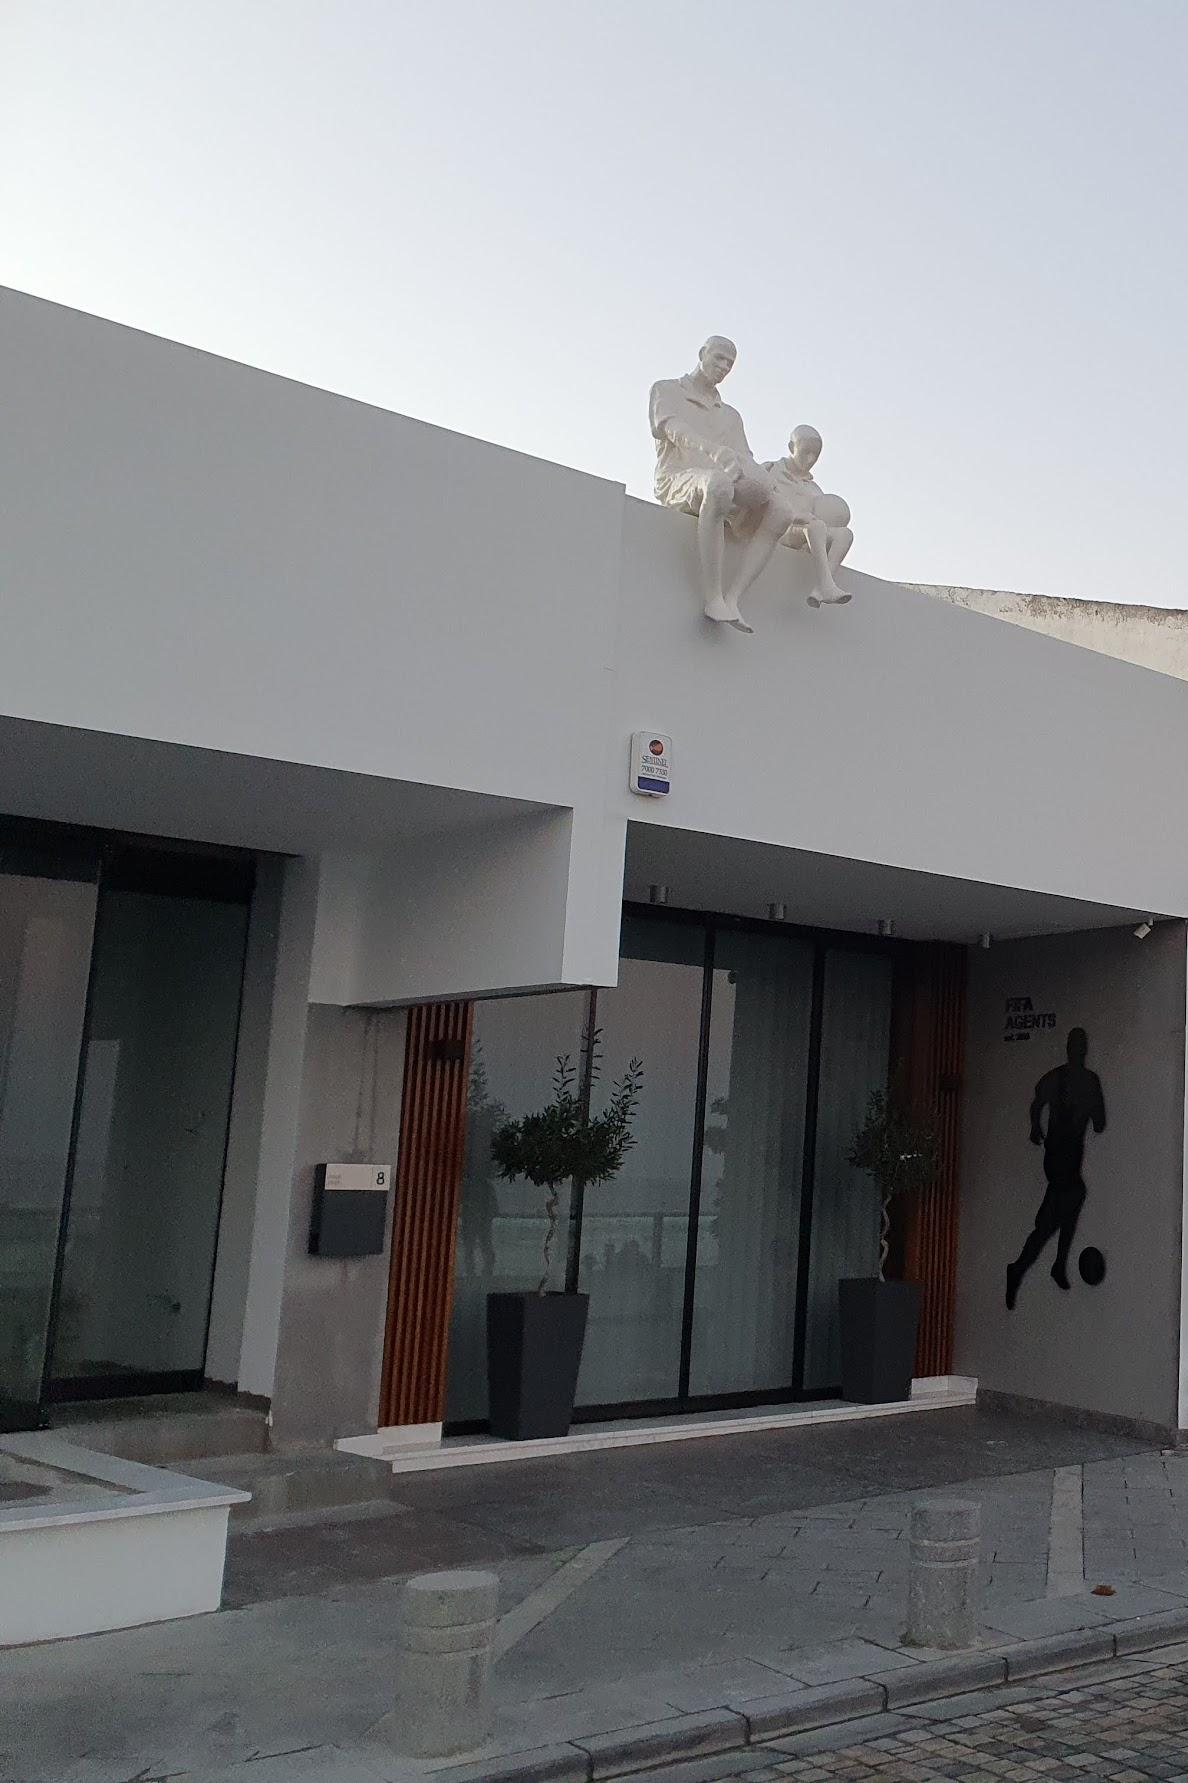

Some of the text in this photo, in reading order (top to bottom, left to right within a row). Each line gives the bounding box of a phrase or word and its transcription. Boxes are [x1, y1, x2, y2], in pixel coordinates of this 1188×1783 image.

[1006, 996, 1033, 1012] FIFA
[1004, 1012, 1057, 1030] AGENTS
[376, 1171, 385, 1185] 8
